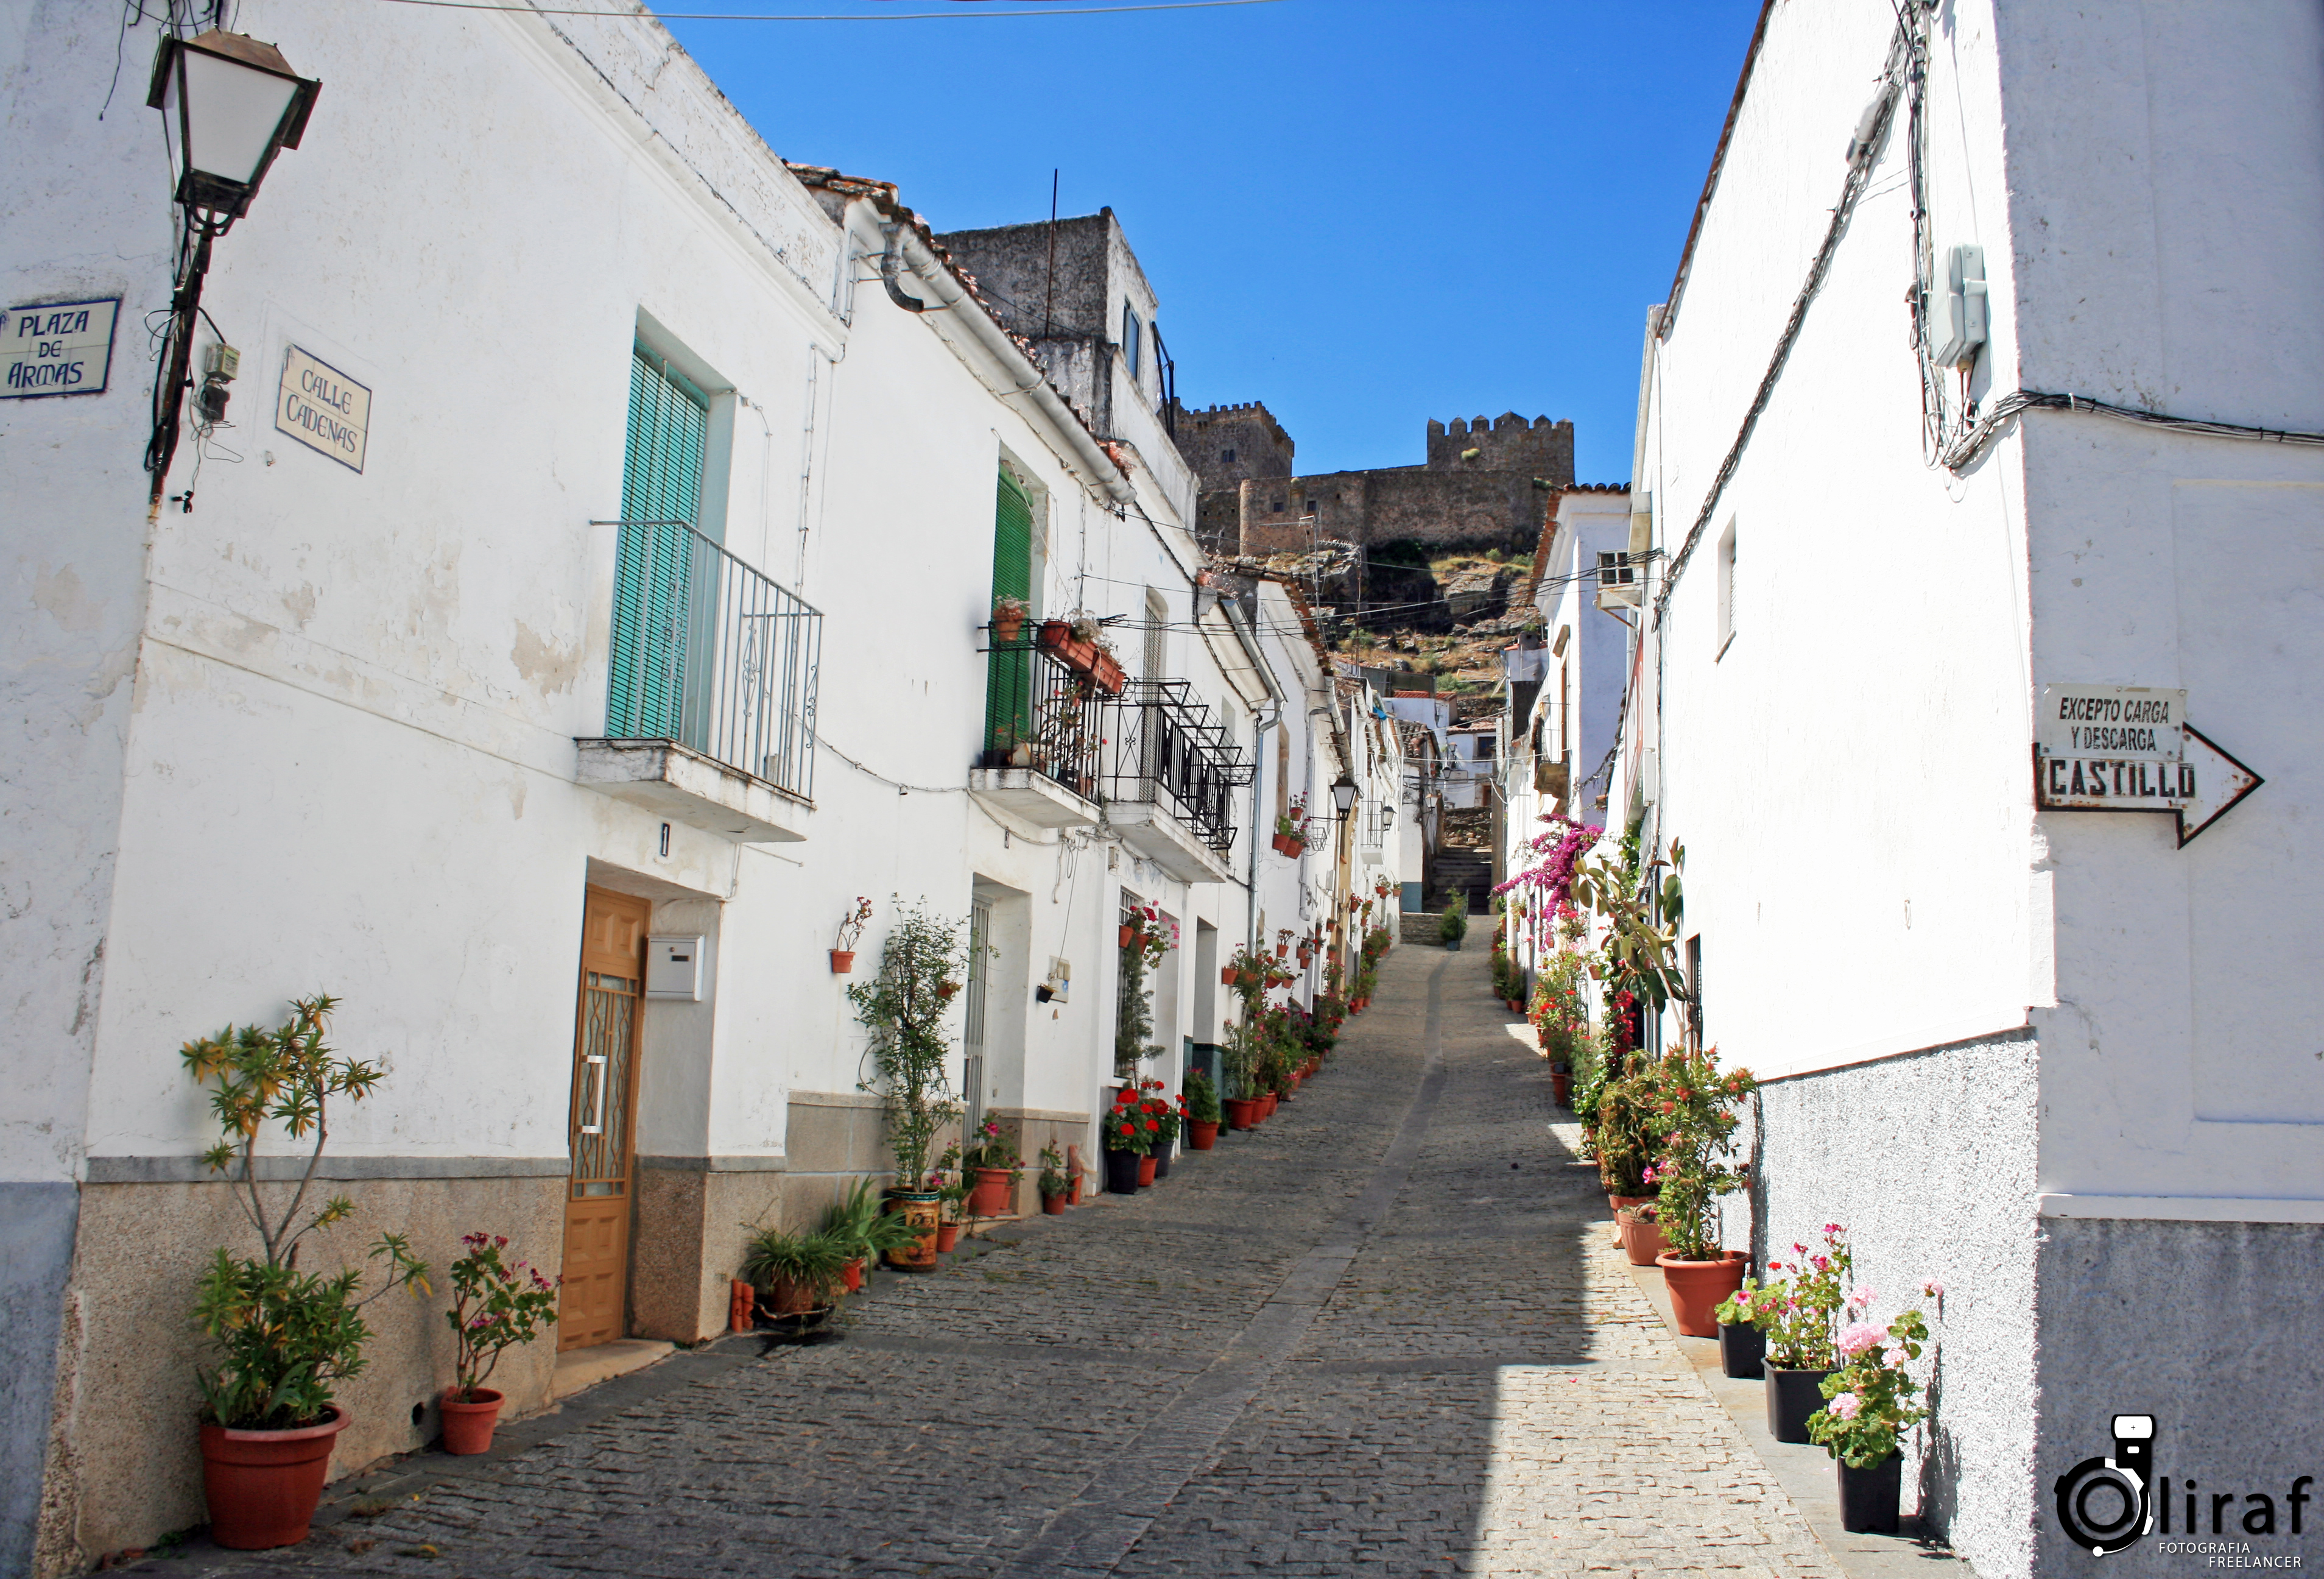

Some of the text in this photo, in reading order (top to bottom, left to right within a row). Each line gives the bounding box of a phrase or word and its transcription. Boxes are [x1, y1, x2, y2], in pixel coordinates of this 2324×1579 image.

[18, 310, 90, 337] PLAZA
[38, 340, 63, 358] DE
[8, 361, 85, 389] ARMAS
[302, 369, 353, 415] CALLE
[287, 394, 357, 453] CADENAS
[2059, 697, 2169, 724] EXCEPTO CARGA
[2071, 726, 2157, 751] Y DESCARGA
[2049, 759, 2195, 798] CASTILLO
